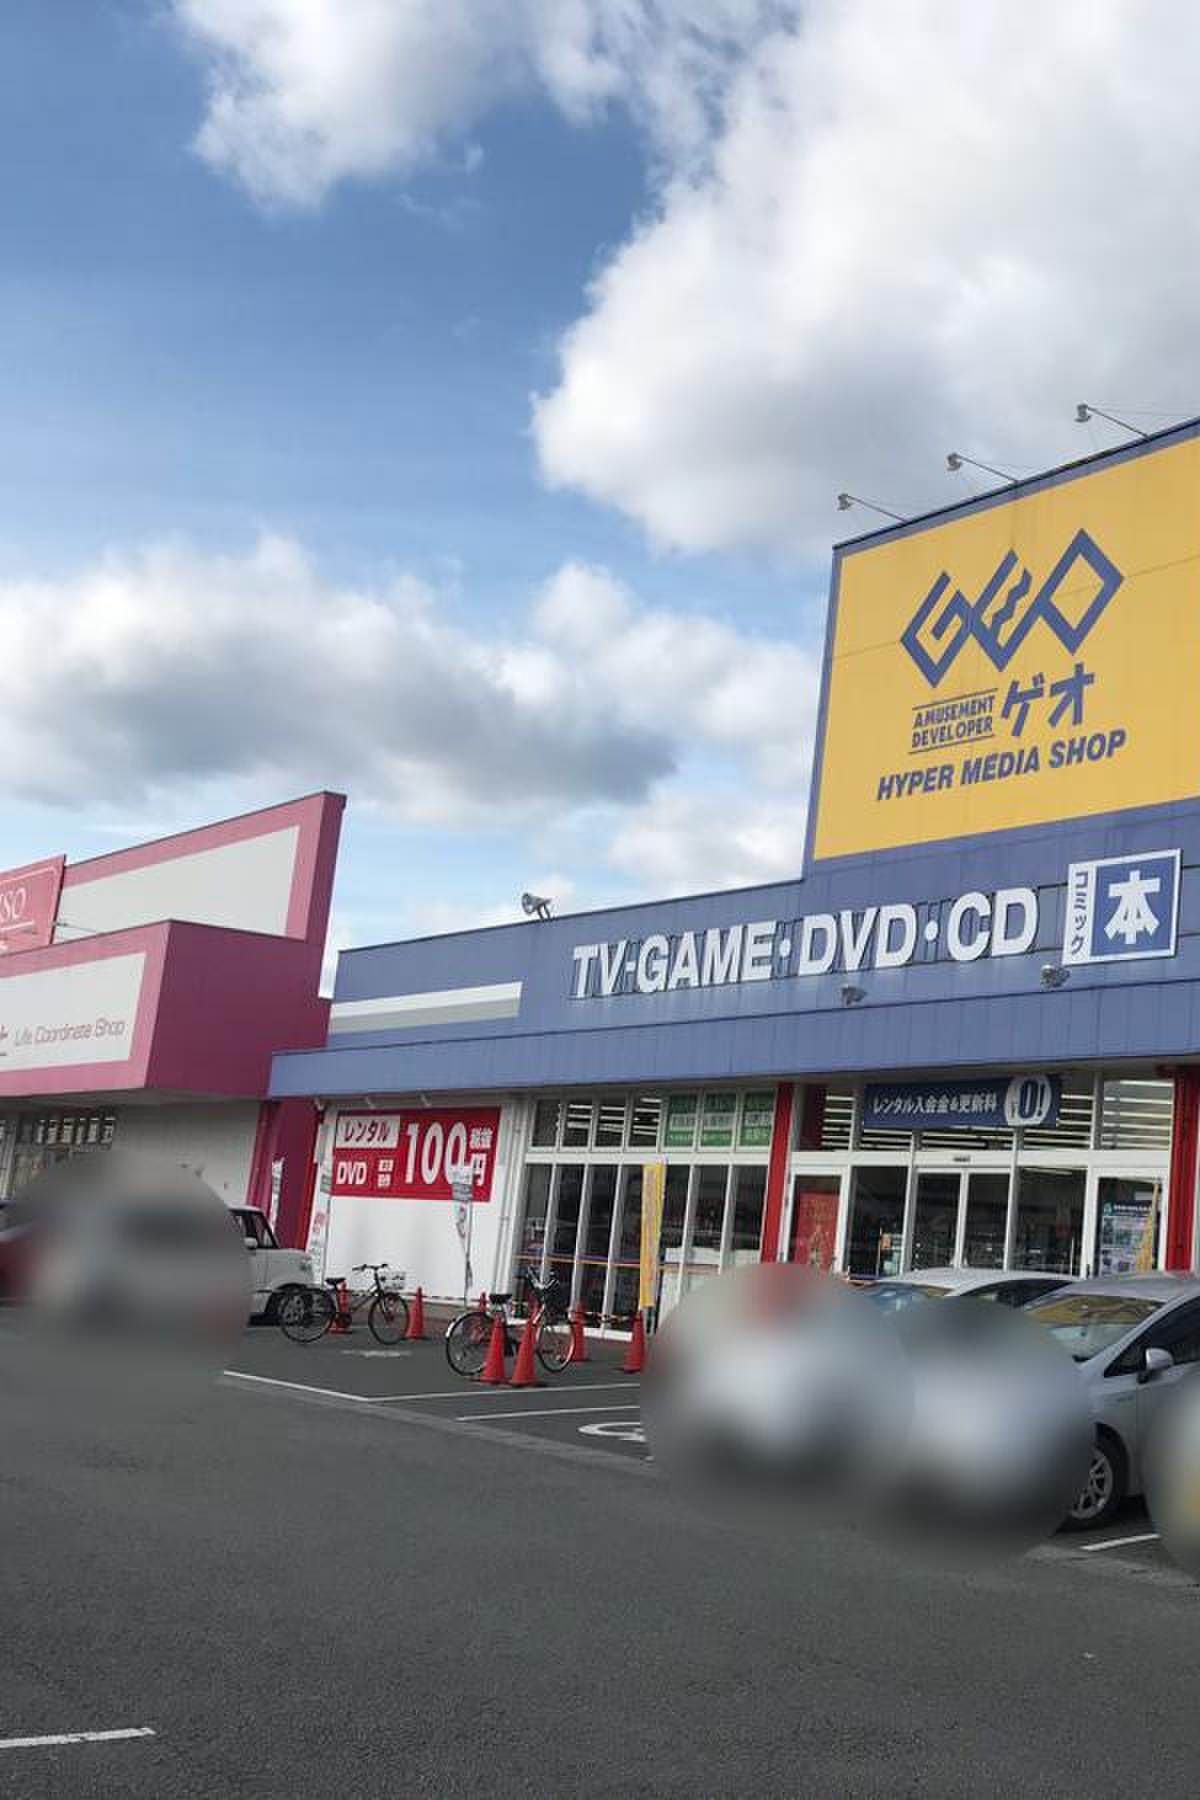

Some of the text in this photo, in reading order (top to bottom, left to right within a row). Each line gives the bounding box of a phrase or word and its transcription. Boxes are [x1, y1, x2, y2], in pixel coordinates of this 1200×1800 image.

[900, 527, 1124, 689] GEO
[913, 696, 995, 731] AMUSEMENT
[1002, 662, 1095, 738] ゲオ
[911, 718, 993, 750] DEVELOPER
[876, 729, 1127, 801] HYPER MEDIA SHOP
[1070, 869, 1089, 956] コミック
[1104, 870, 1160, 945] 本
[95, 1017, 126, 1037] Shop
[344, 1119, 391, 1143] レンタル
[335, 1161, 368, 1185] DVD
